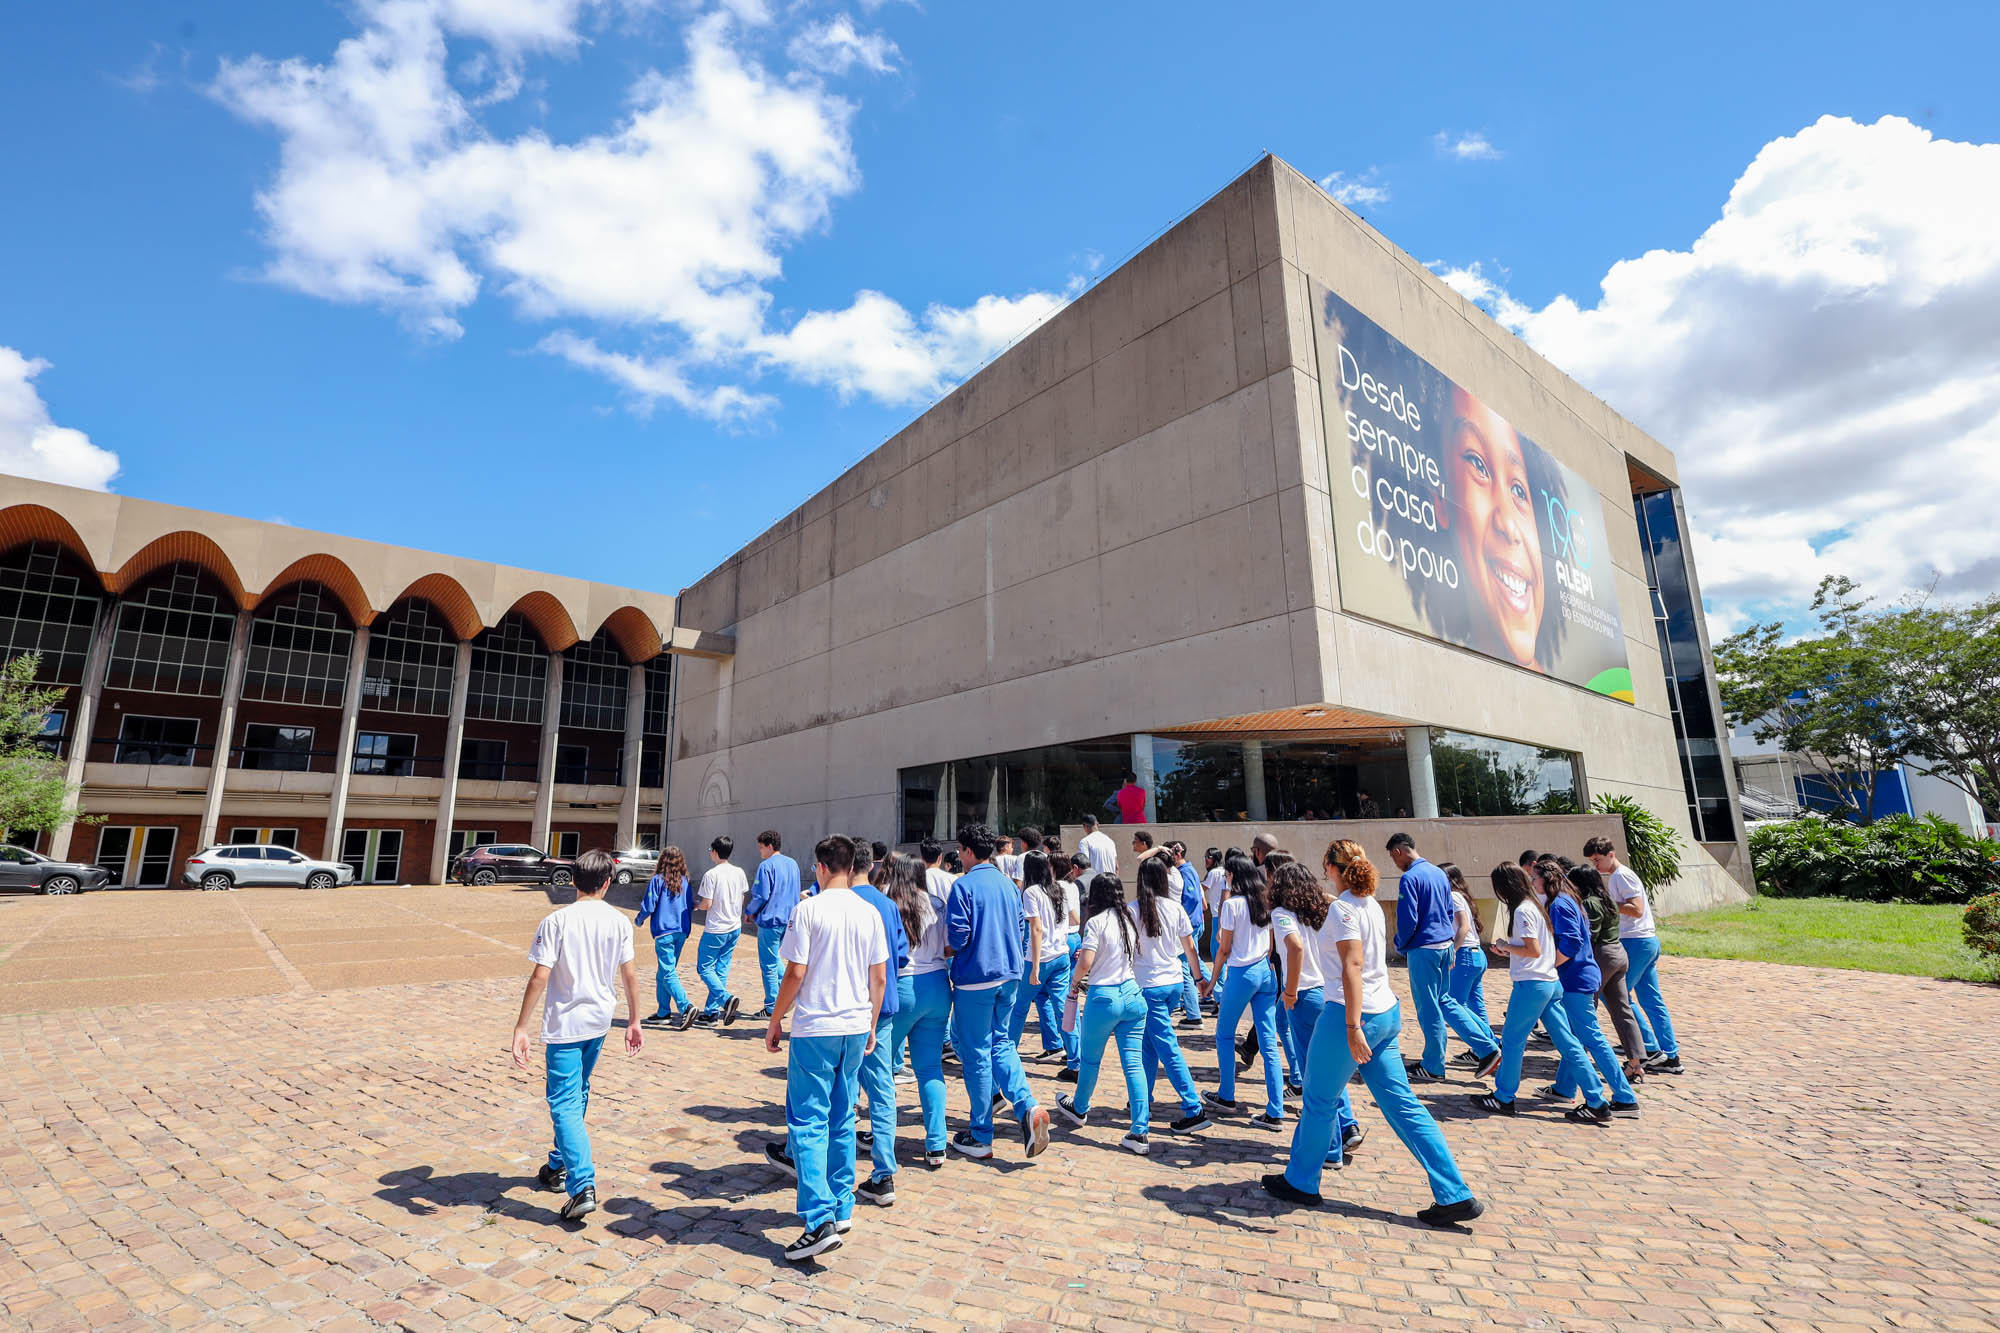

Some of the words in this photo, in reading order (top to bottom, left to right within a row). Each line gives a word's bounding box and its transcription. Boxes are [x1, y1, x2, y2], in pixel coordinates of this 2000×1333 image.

[1338, 344, 1421, 432] Desde
[1345, 409, 1446, 498] sempre,
[1352, 465, 1370, 501] a
[1376, 477, 1437, 532] casa
[1357, 512, 1394, 562] do
[1400, 537, 1459, 589] povo
[1555, 559, 1594, 600] ALEPI
